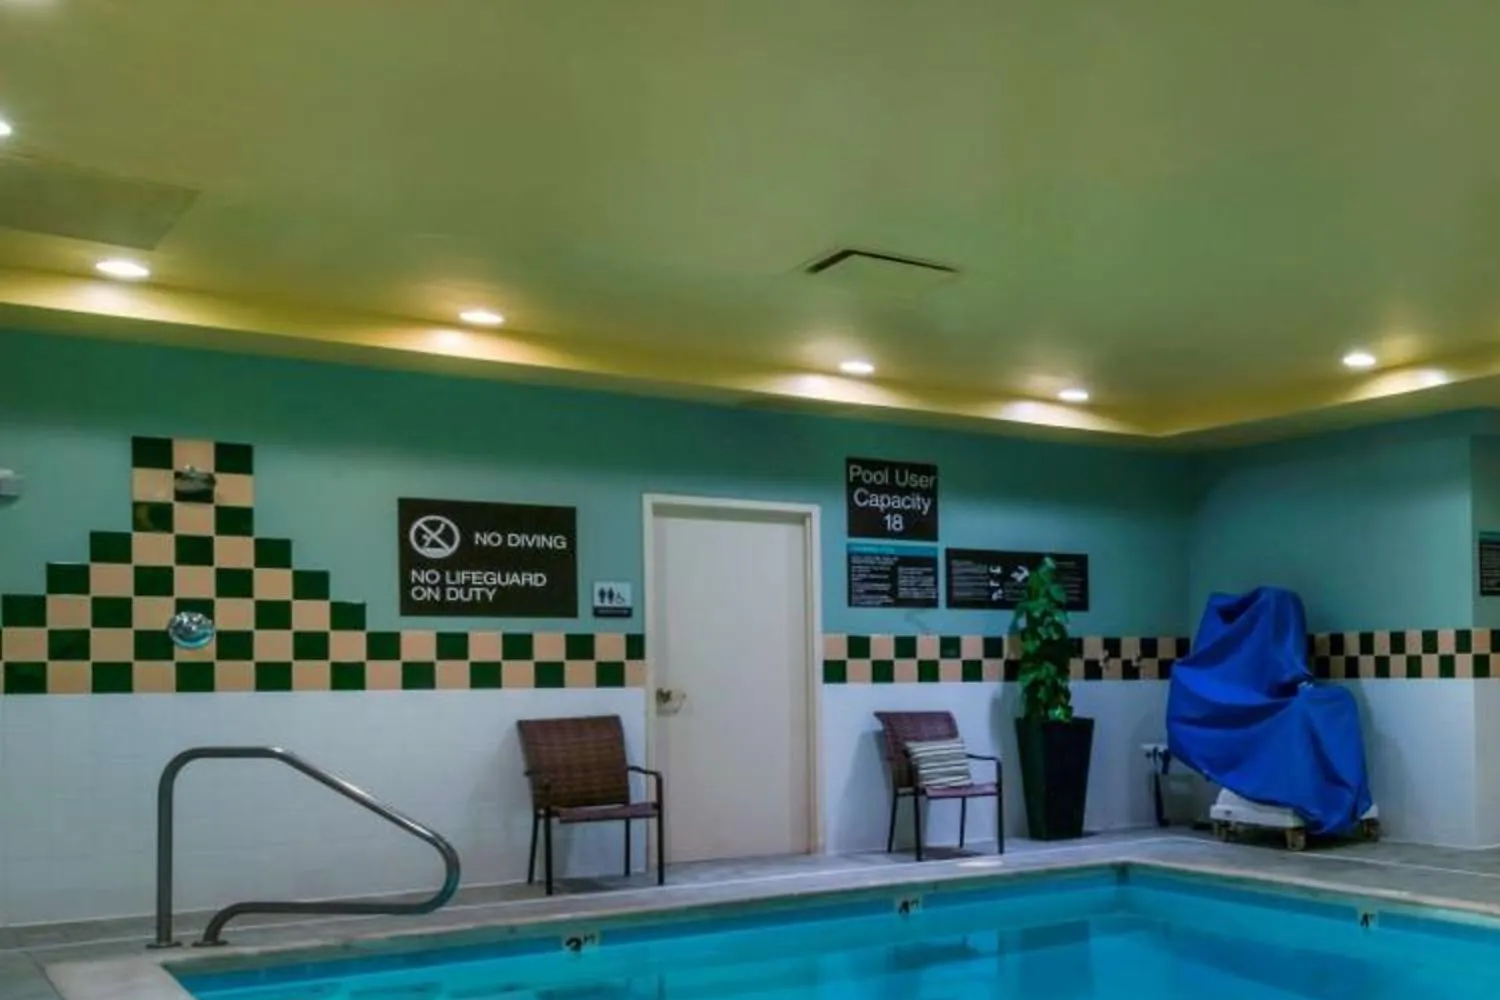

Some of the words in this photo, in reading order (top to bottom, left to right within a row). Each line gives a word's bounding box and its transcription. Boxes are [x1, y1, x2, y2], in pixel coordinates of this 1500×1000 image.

[849, 464, 889, 485] Pool
[895, 468, 935, 489] User
[853, 487, 932, 516] Capacity
[884, 513, 904, 532] 18
[474, 532, 502, 548] NO
[507, 533, 568, 550] DIVING
[410, 569, 441, 585] NO
[445, 570, 548, 588] LIFEGUARD
[411, 586, 441, 602] ON
[446, 587, 498, 603] DUTY
